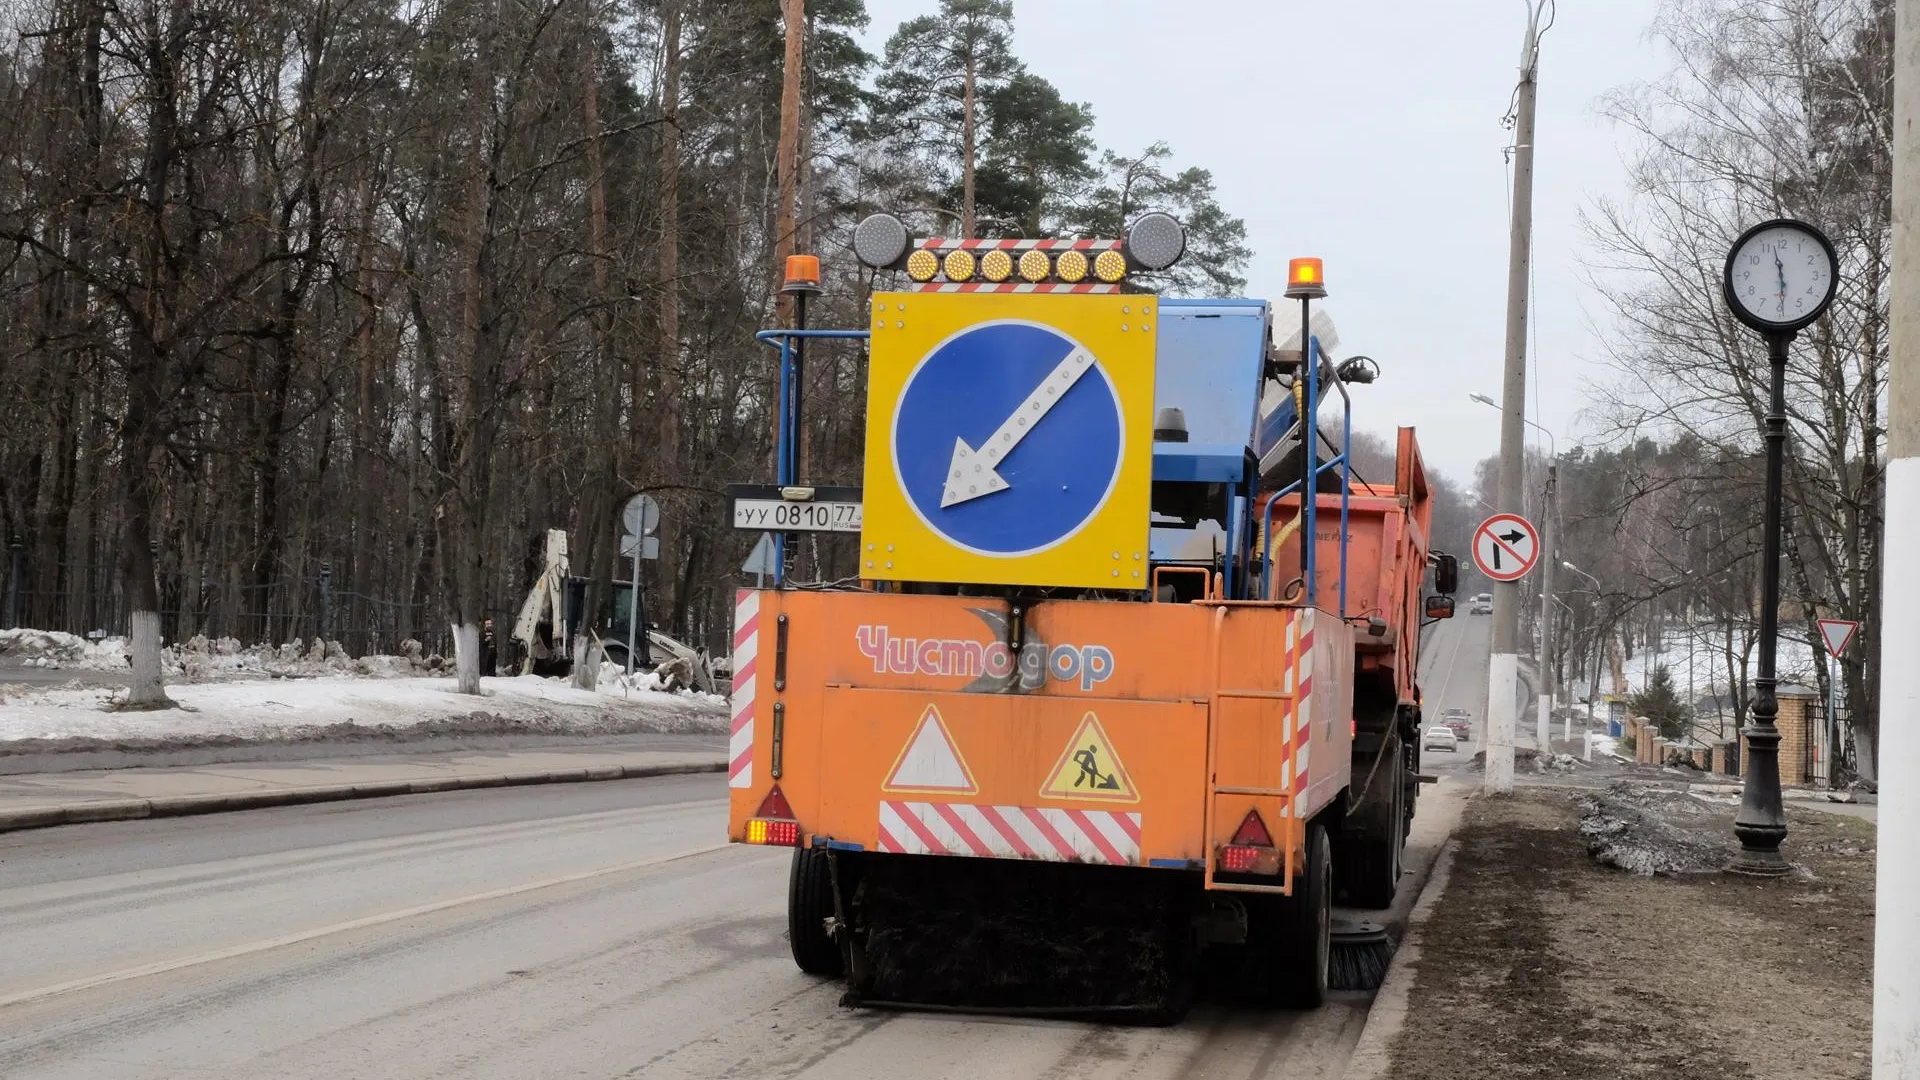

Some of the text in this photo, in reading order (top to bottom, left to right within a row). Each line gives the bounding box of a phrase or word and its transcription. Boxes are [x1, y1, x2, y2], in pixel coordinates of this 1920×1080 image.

[1762, 243, 1770, 253] 11
[1777, 240, 1788, 249] 12
[1797, 244, 1801, 252] 1
[1750, 255, 1759, 265] 10
[1808, 255, 1814, 265] 2
[1743, 271, 1750, 280] 9
[1812, 271, 1818, 280] 3
[1748, 286, 1755, 295] 8
[1806, 286, 1813, 294] 4
[1760, 298, 1766, 307] 7
[1796, 297, 1802, 307] 5
[1776, 303, 1784, 312] 6
[775, 505, 829, 526] 0810
[835, 506, 856, 521] 77
[856, 625, 1114, 691] Чистодор
